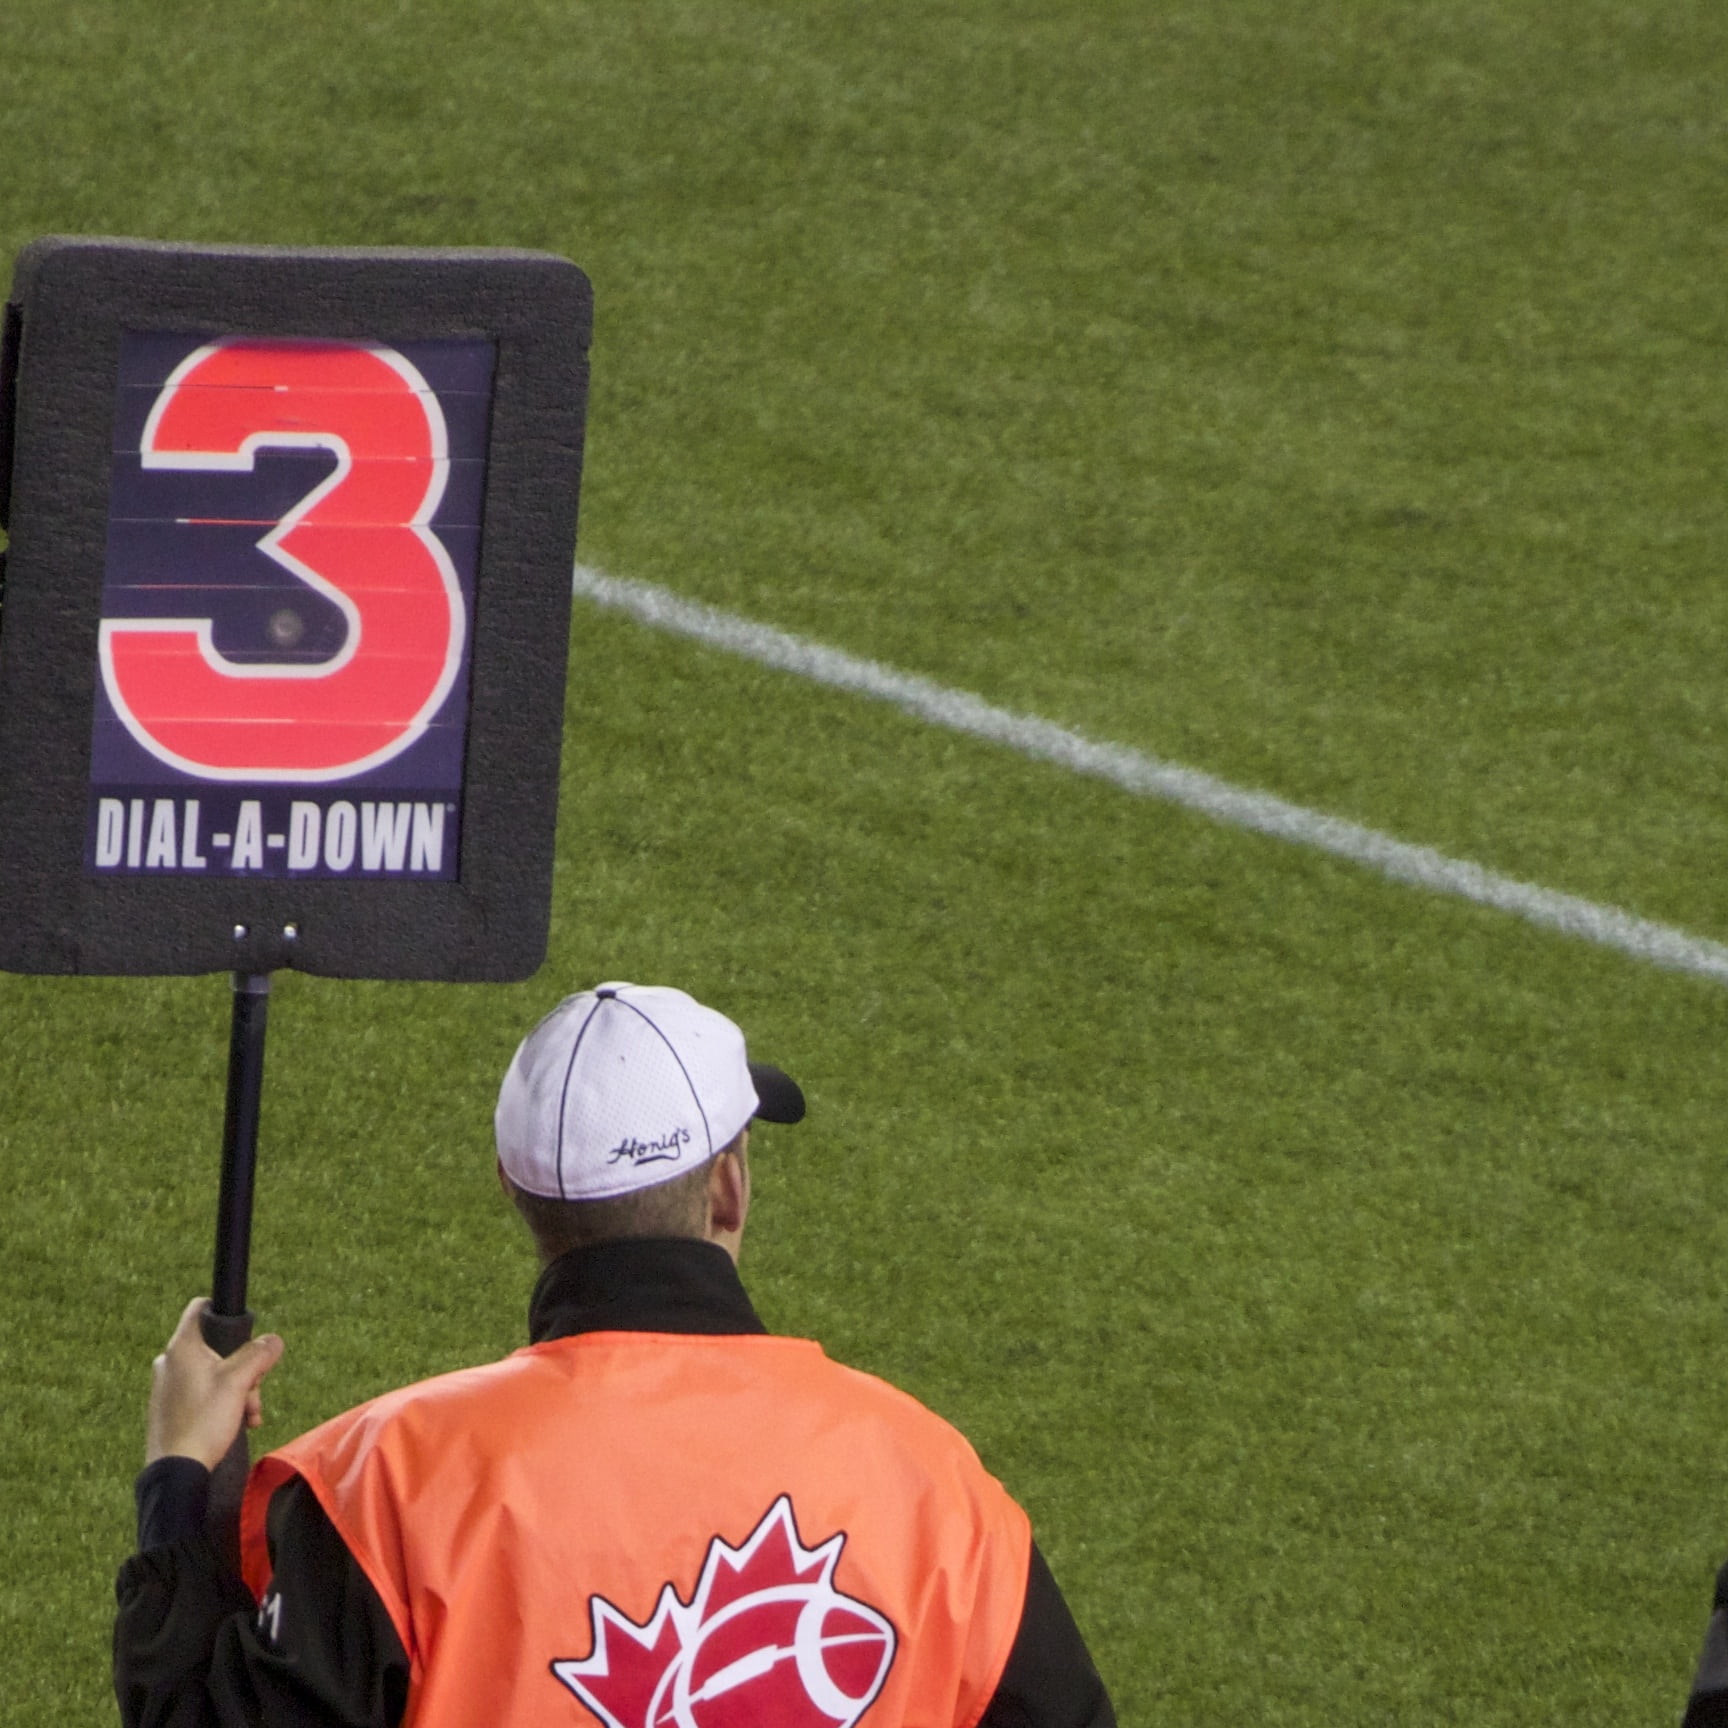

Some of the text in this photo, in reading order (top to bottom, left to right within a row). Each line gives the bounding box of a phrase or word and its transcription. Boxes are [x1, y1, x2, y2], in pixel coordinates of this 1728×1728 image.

[99, 336, 465, 782] 3
[95, 798, 446, 872] DIAL-A-DOWN
[606, 1127, 690, 1166] Honig's
